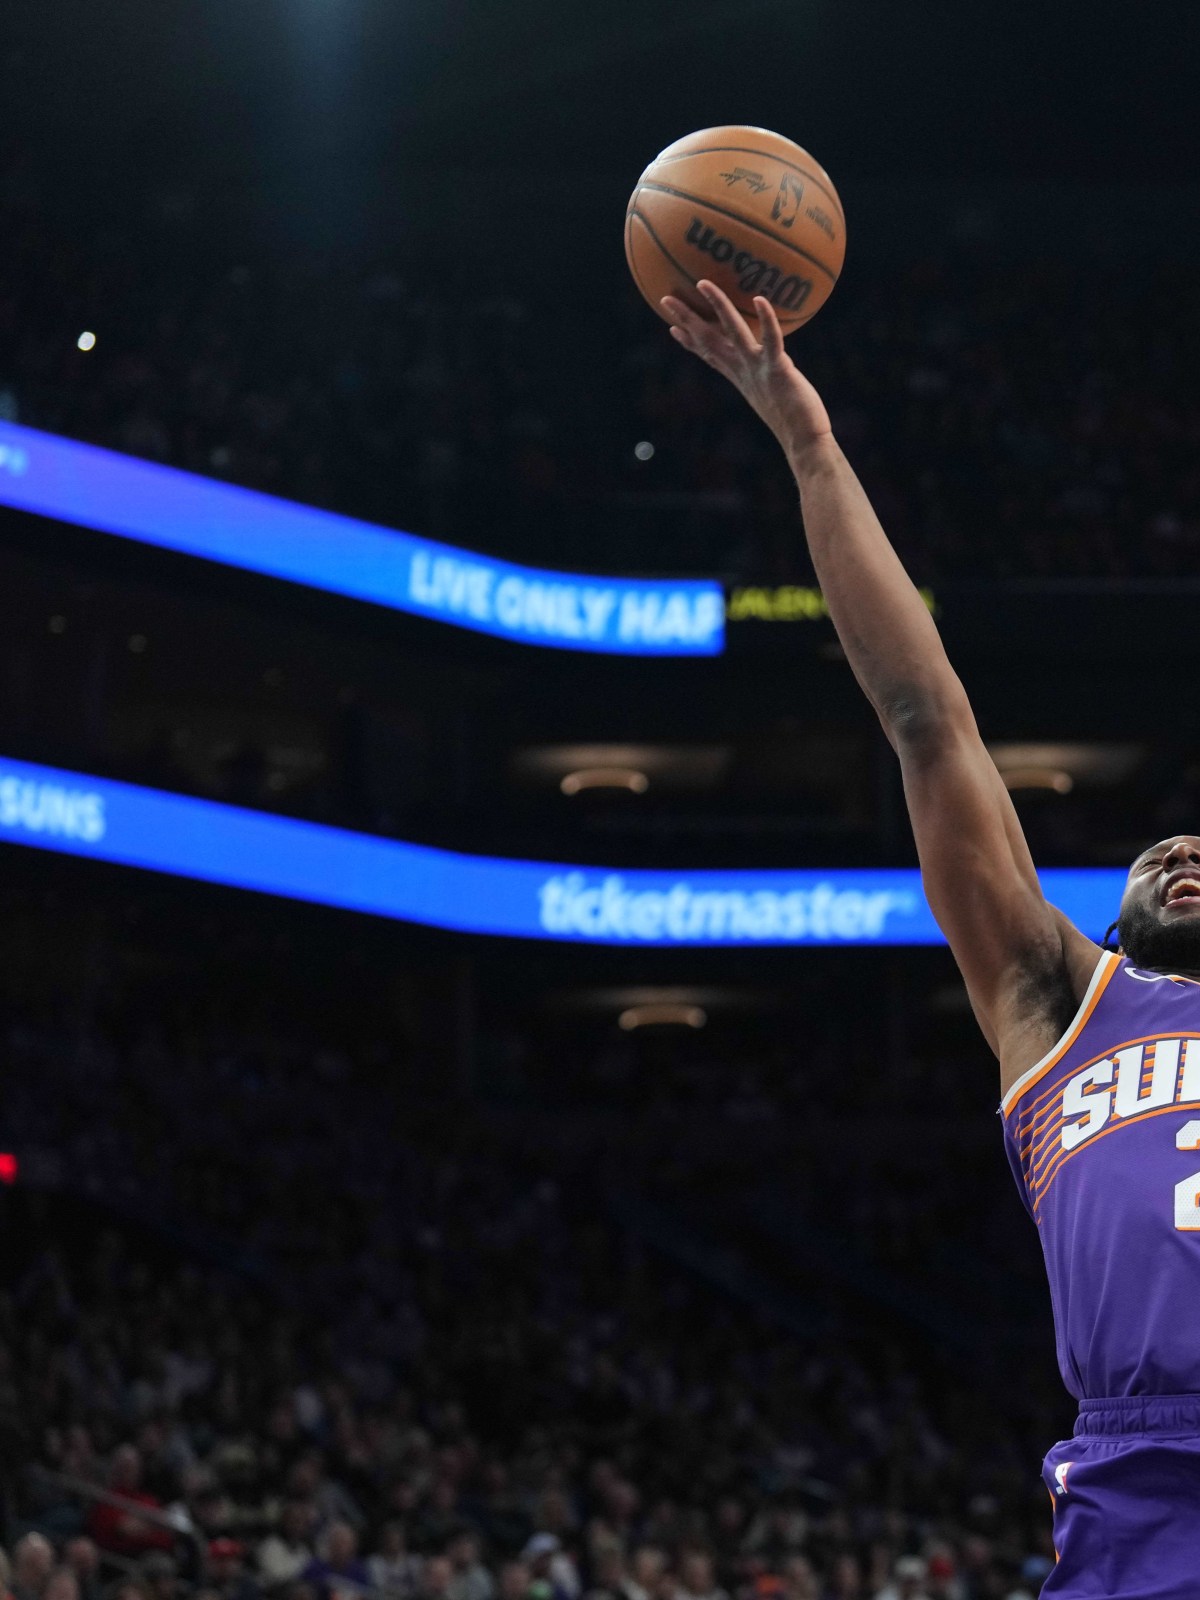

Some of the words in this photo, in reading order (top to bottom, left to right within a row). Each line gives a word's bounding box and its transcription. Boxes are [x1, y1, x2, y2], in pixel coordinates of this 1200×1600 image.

[685, 216, 813, 313] Wilson
[411, 553, 494, 621] LIVE
[496, 577, 615, 640] ONLY
[0, 776, 105, 841] SUNS
[540, 873, 893, 940] ticketmaster
